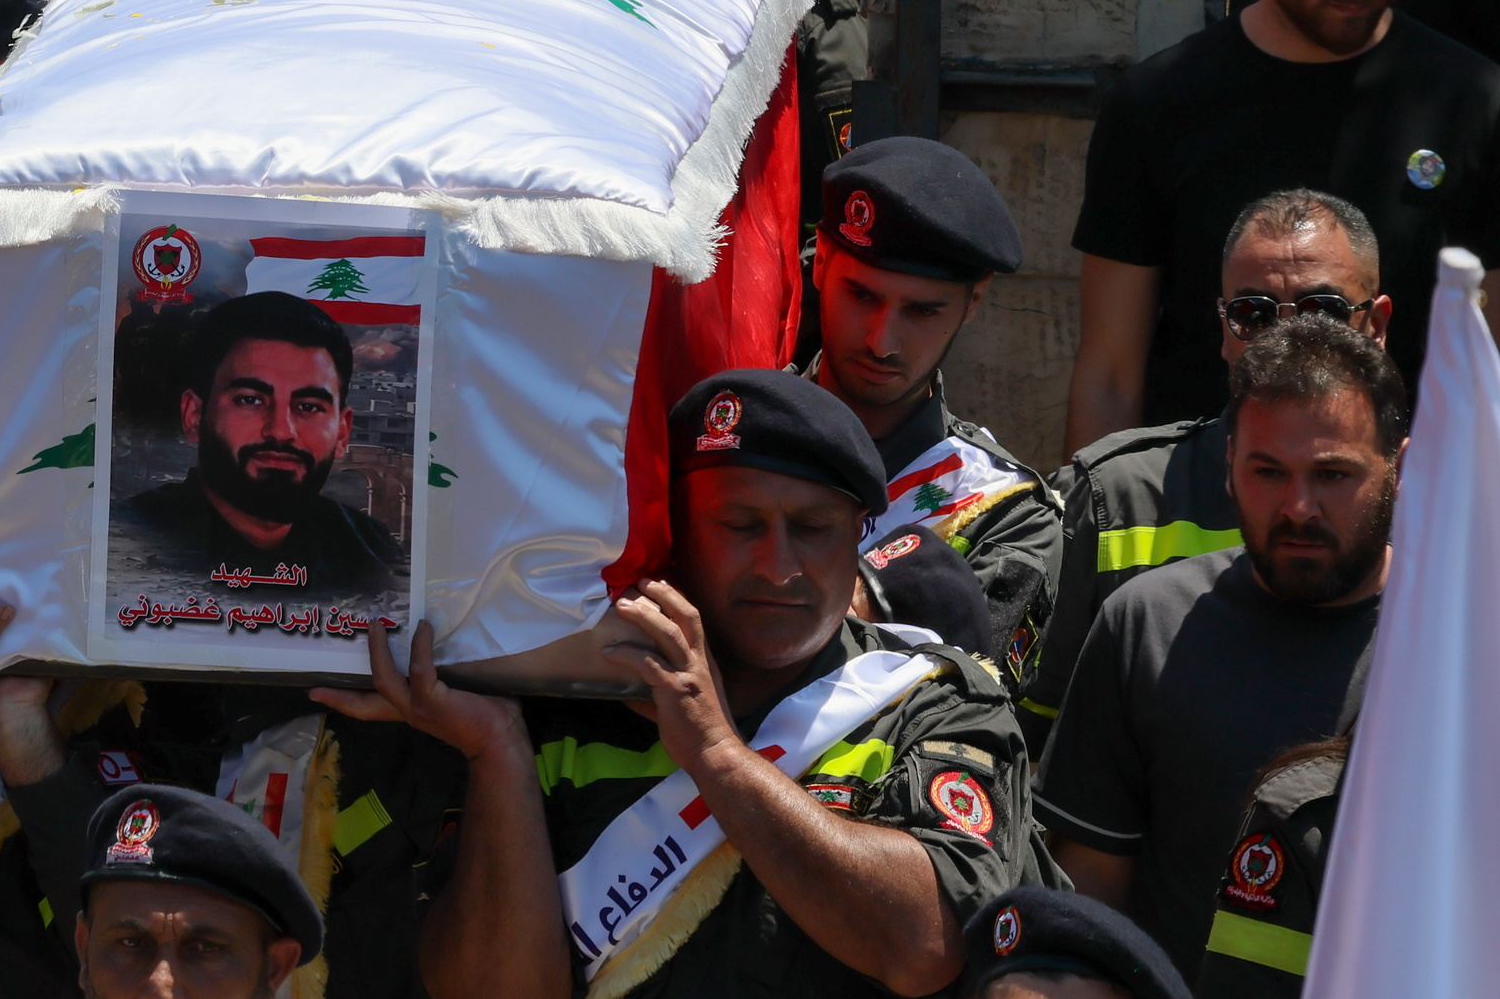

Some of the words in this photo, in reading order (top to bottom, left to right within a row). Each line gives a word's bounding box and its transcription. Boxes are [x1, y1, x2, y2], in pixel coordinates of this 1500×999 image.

[211, 562, 307, 588] الشهيد
[118, 594, 221, 626] غضبوني
[226, 602, 319, 634] إبراهيم
[599, 835, 687, 946] الدفاع
